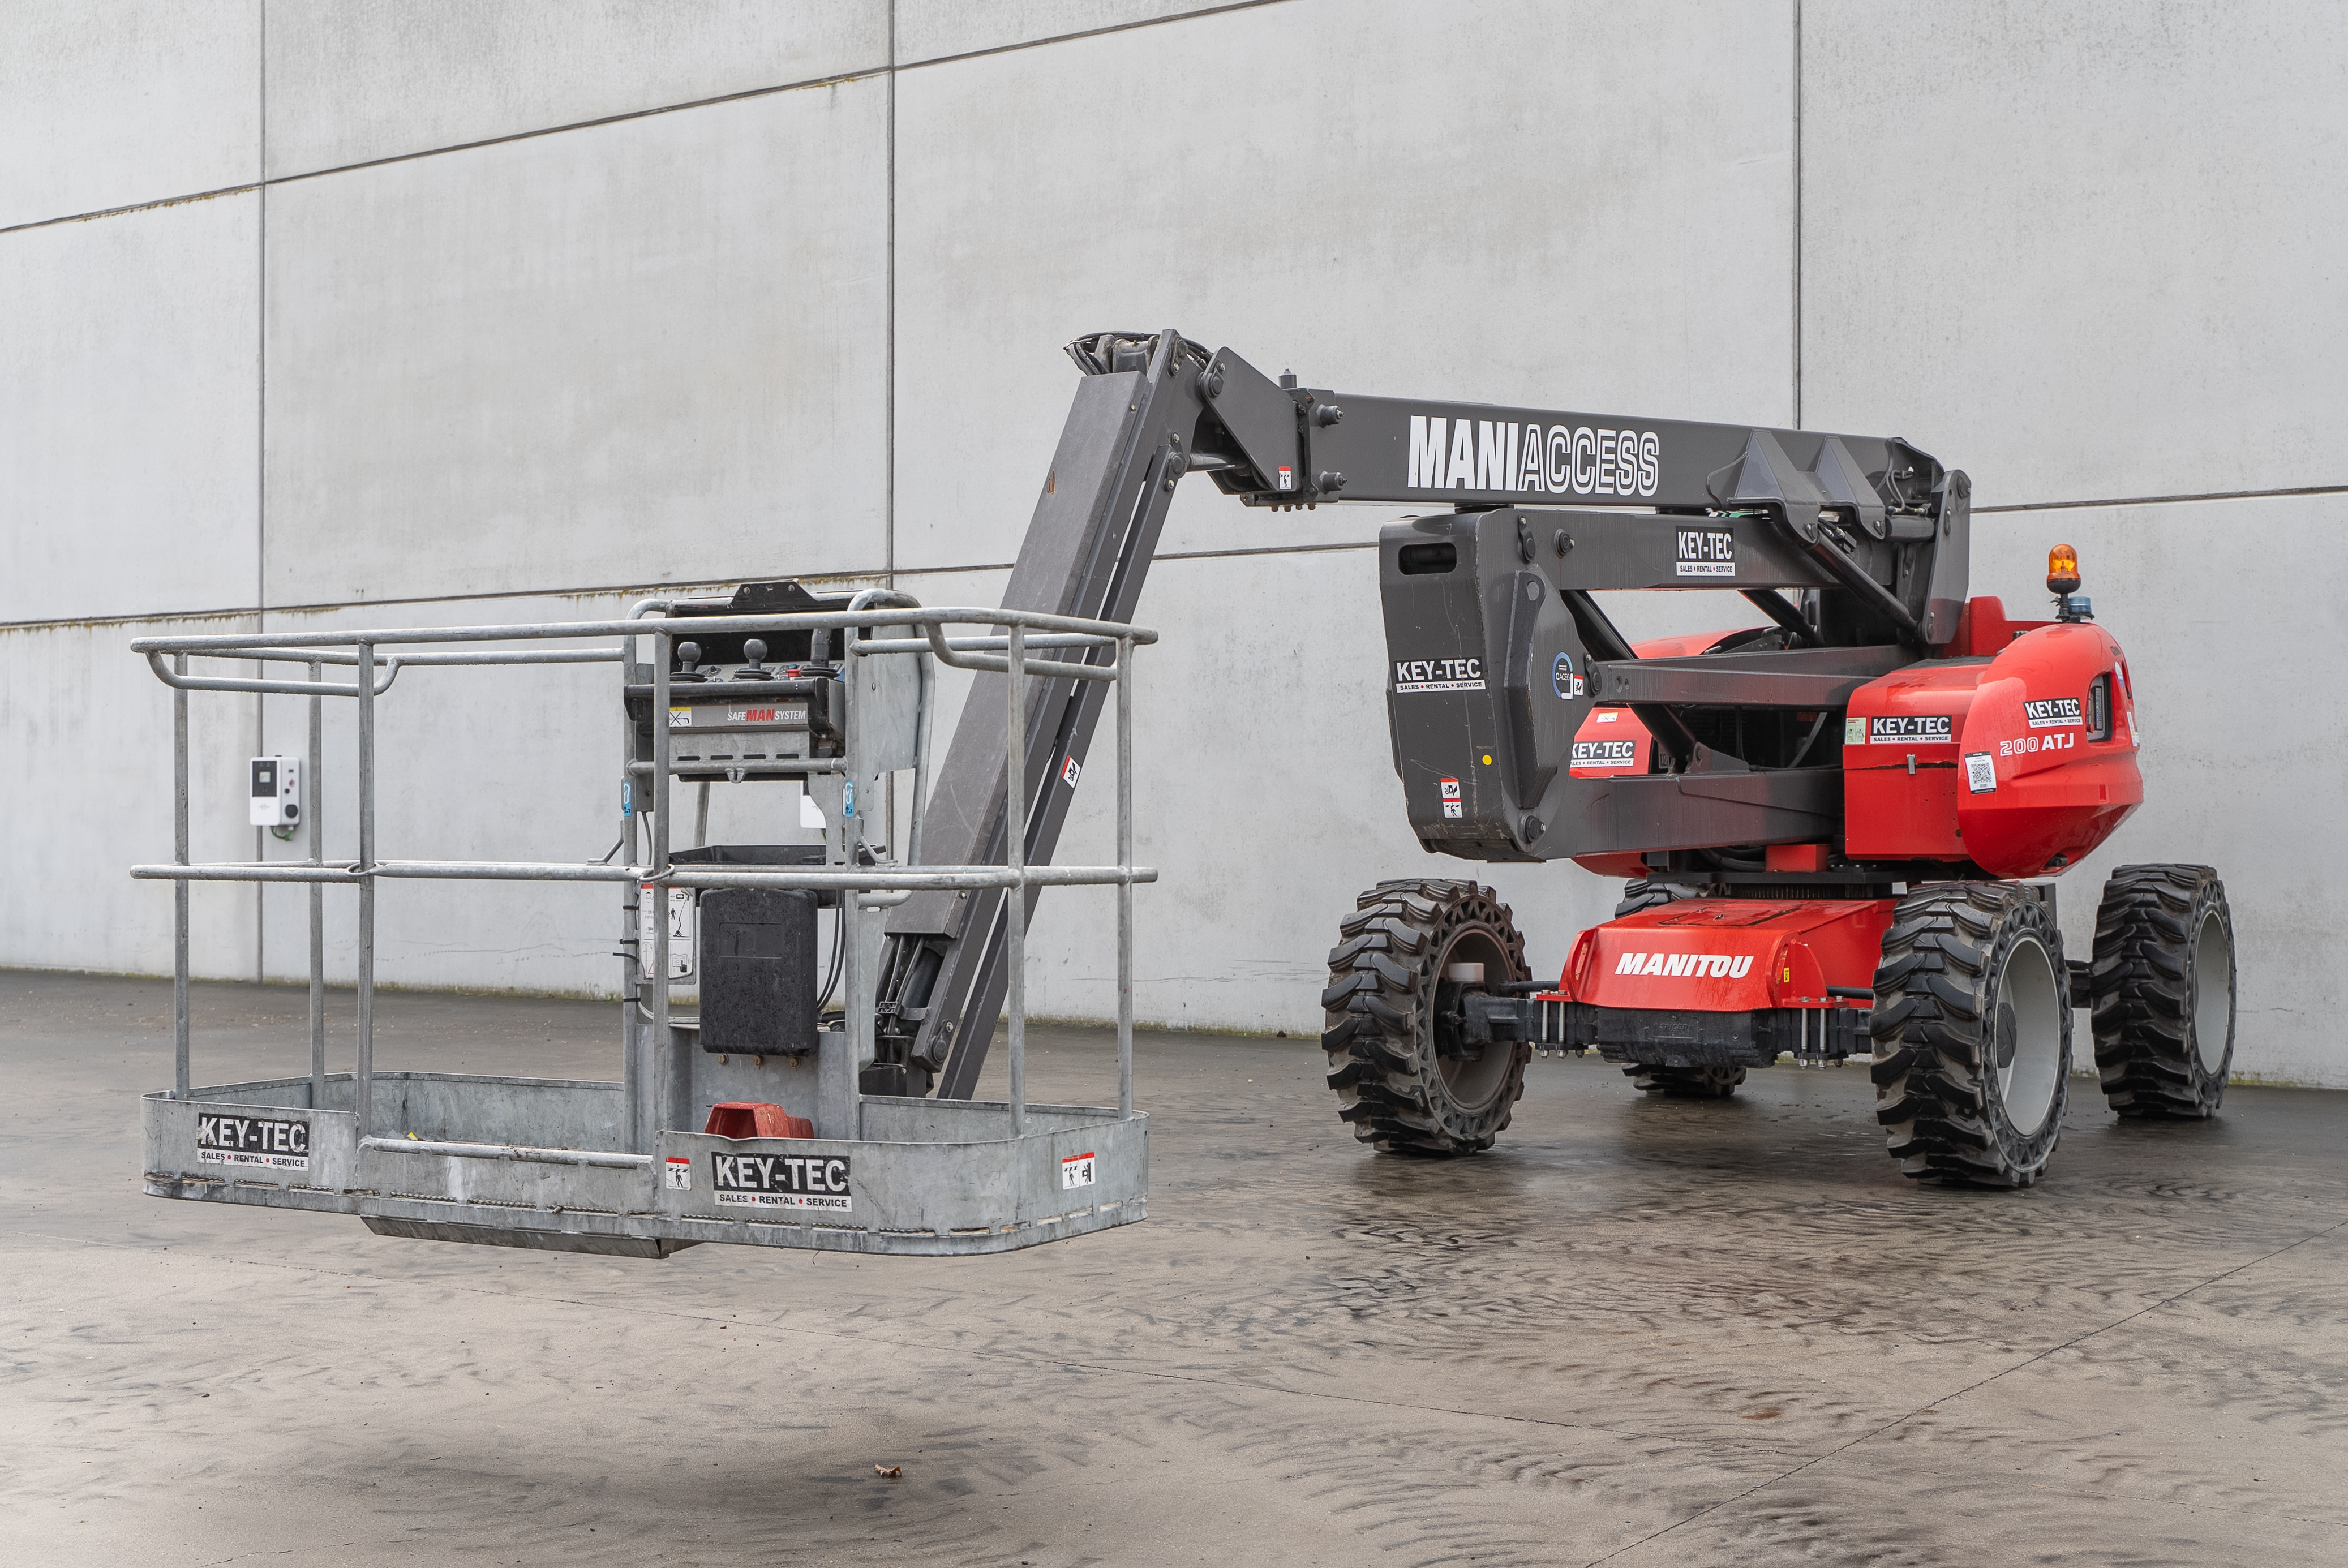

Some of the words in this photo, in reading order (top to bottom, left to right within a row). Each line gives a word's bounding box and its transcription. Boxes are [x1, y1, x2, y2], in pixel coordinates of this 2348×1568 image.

[1407, 415, 1659, 497] MANIACCESS
[1678, 531, 1732, 560] KEY-TEC
[1396, 659, 1481, 681] KEY-TEC
[2025, 699, 2080, 719] KEY-TEC
[1873, 716, 1950, 734] KEY-TEC
[1999, 737, 2039, 757] 200
[2041, 732, 2074, 751] ATJ
[1614, 952, 1754, 978] MANITOU
[201, 1116, 306, 1153] KEY-TEC
[201, 1152, 225, 1161] SALES
[234, 1155, 264, 1164] RENTAL
[272, 1158, 305, 1167] SERVICE
[716, 1155, 847, 1192] KEY-TEC
[719, 1194, 748, 1203] SALES
[759, 1196, 796, 1205] RENTAL
[806, 1198, 847, 1208] SERVICE
